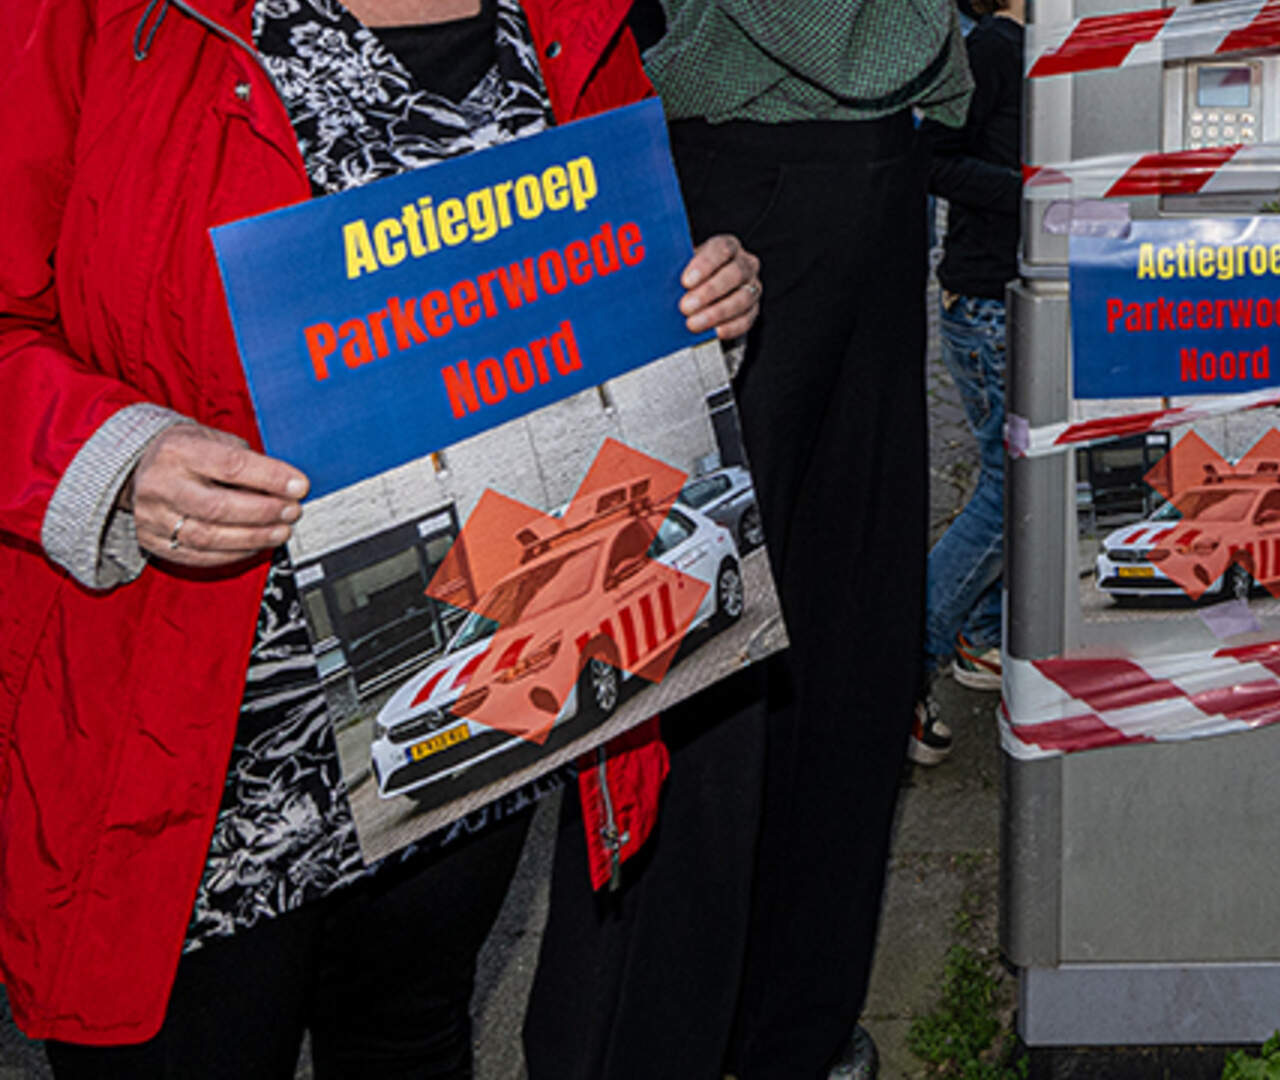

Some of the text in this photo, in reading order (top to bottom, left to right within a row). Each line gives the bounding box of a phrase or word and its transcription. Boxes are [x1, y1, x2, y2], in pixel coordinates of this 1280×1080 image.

[342, 156, 597, 278] Actiegroep
[303, 223, 645, 382] Parkeerwoede
[440, 320, 583, 419] Noord
[1180, 345, 1270, 382] Noord
